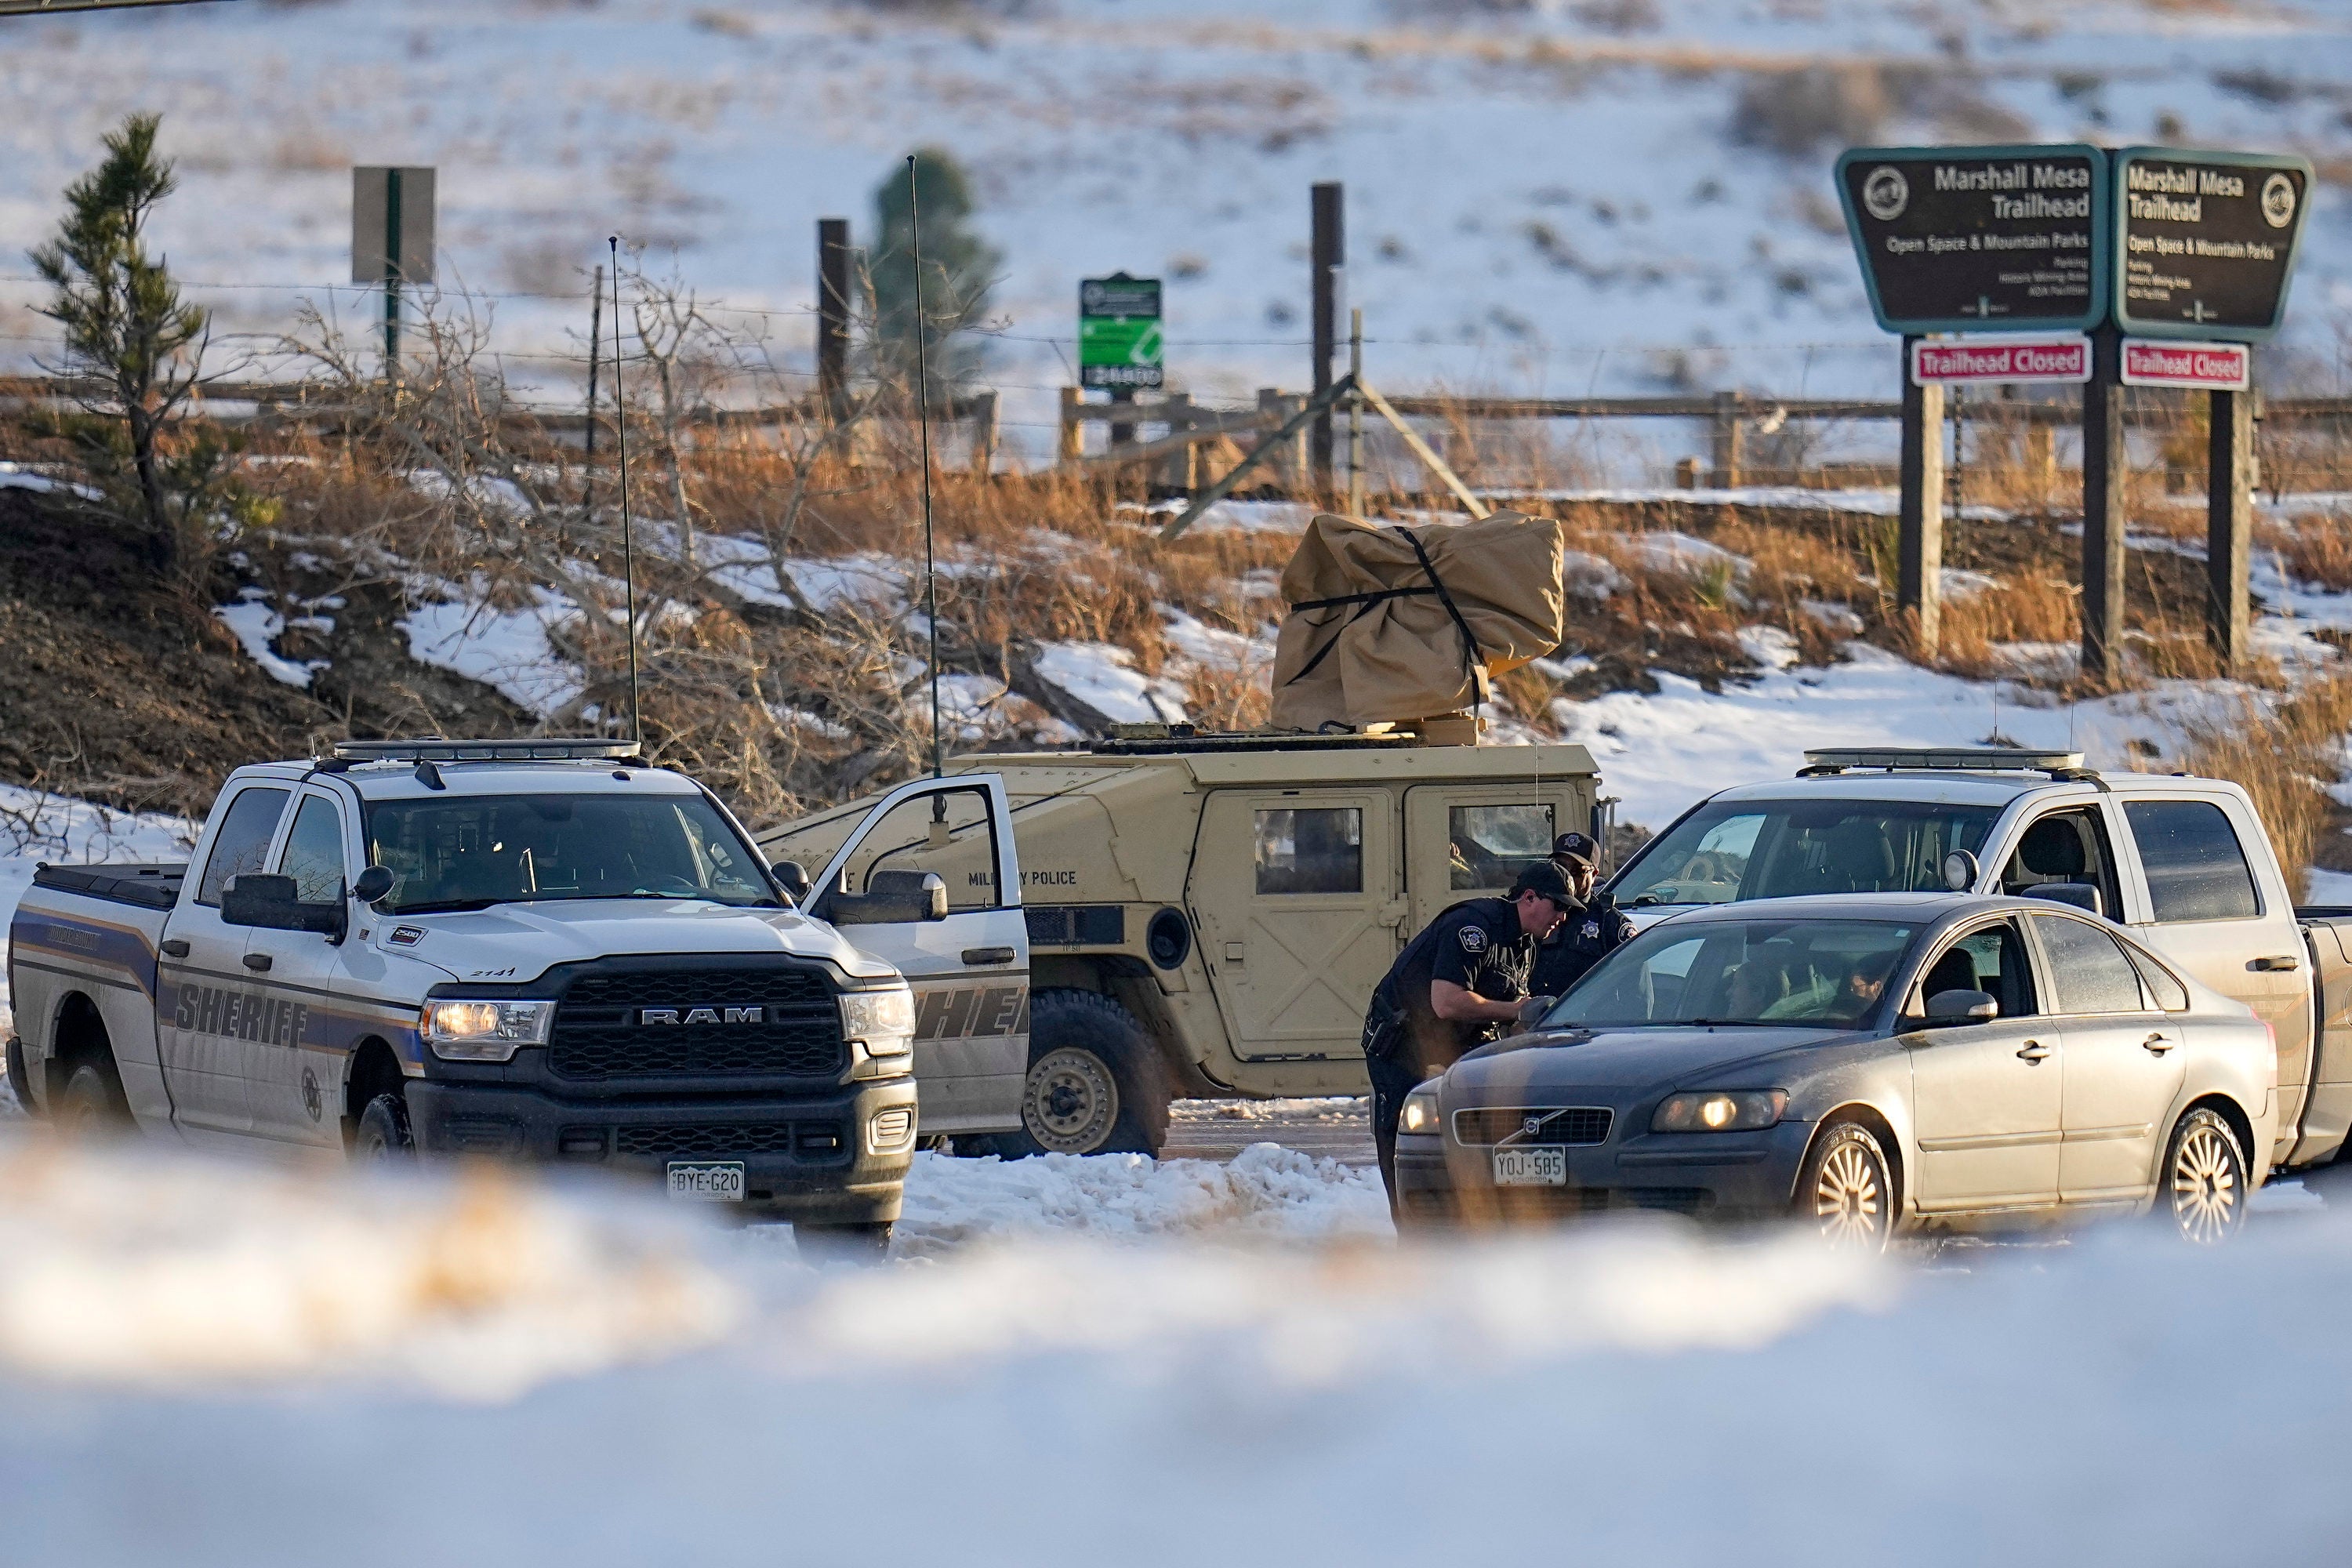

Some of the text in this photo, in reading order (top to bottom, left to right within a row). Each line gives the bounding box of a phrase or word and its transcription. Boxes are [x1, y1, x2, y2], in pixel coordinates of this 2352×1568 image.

[1934, 163, 2090, 191] Marshall Mesa
[2128, 166, 2245, 197] Marshall Mesa
[1992, 193, 2090, 220] Trailhead
[2129, 194, 2201, 223] Trailhead
[1886, 232, 2089, 255] Open Space & Mountain Parks
[2128, 235, 2275, 261] Open Space & Mountain Parks
[1922, 347, 2081, 374] Trailhead Closed
[2130, 350, 2241, 378] Trailhead Closed
[1033, 871, 1076, 885] POLICE
[395, 929, 419, 938] 2500
[470, 967, 516, 977] 2141
[176, 983, 307, 1049] SHERIFF
[641, 1007, 762, 1025] RAM
